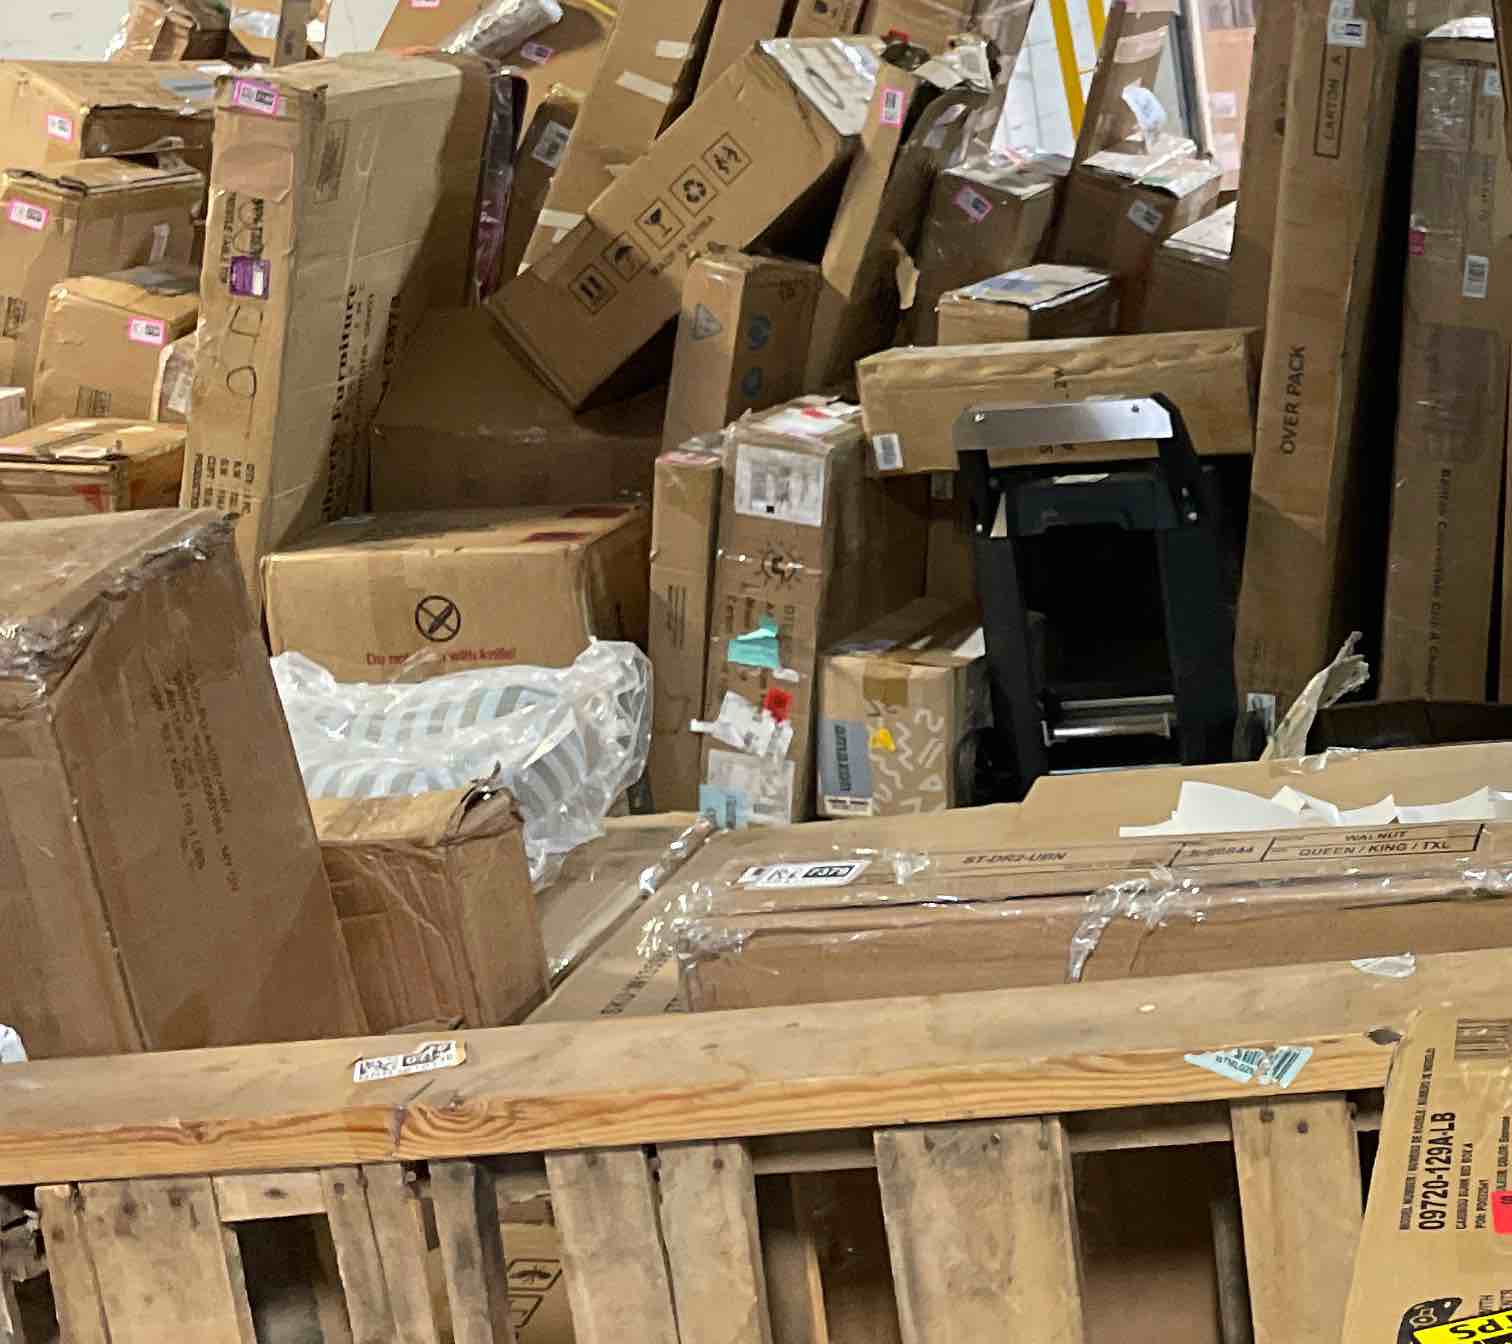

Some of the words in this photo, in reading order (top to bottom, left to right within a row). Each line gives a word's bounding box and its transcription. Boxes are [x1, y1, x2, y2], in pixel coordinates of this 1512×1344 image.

[1285, 345, 1306, 397] PACK
[1279, 401, 1301, 455] OVER
[1300, 846, 1356, 857] QUEEN
[1368, 842, 1408, 854] KING
[1417, 1111, 1456, 1230] 09720-129A-LB
